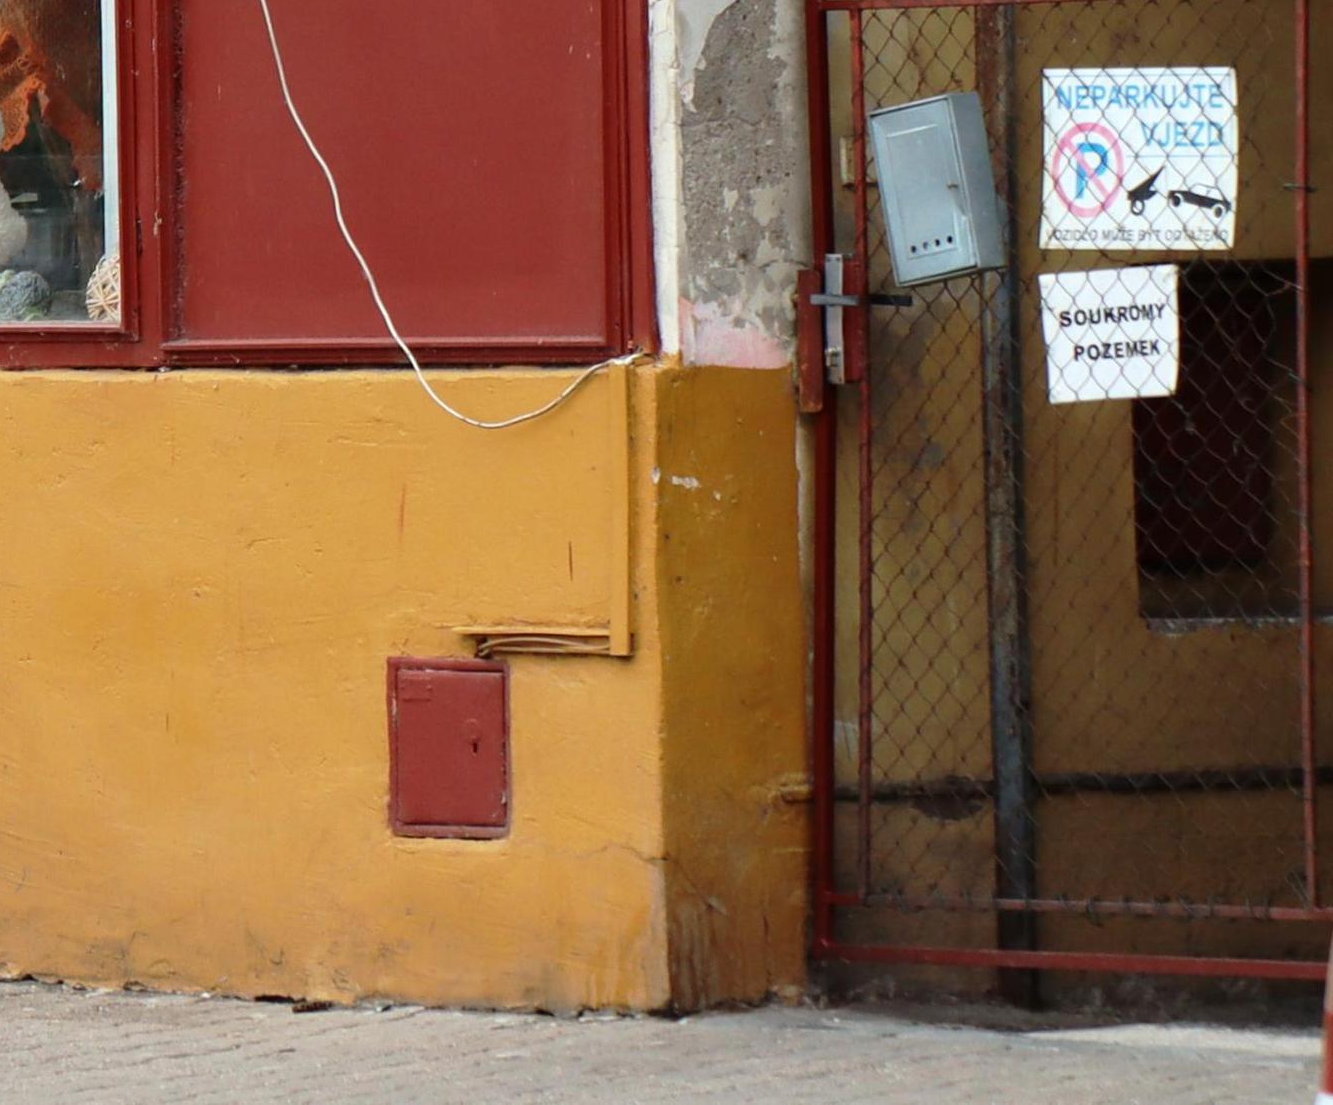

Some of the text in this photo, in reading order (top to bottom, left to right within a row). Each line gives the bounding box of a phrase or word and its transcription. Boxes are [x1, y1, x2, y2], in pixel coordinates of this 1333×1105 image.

[1055, 83, 1224, 110] NEPARKUJTE
[1140, 120, 1224, 147] VJEZD
[1074, 339, 1160, 362] POZEMEK
